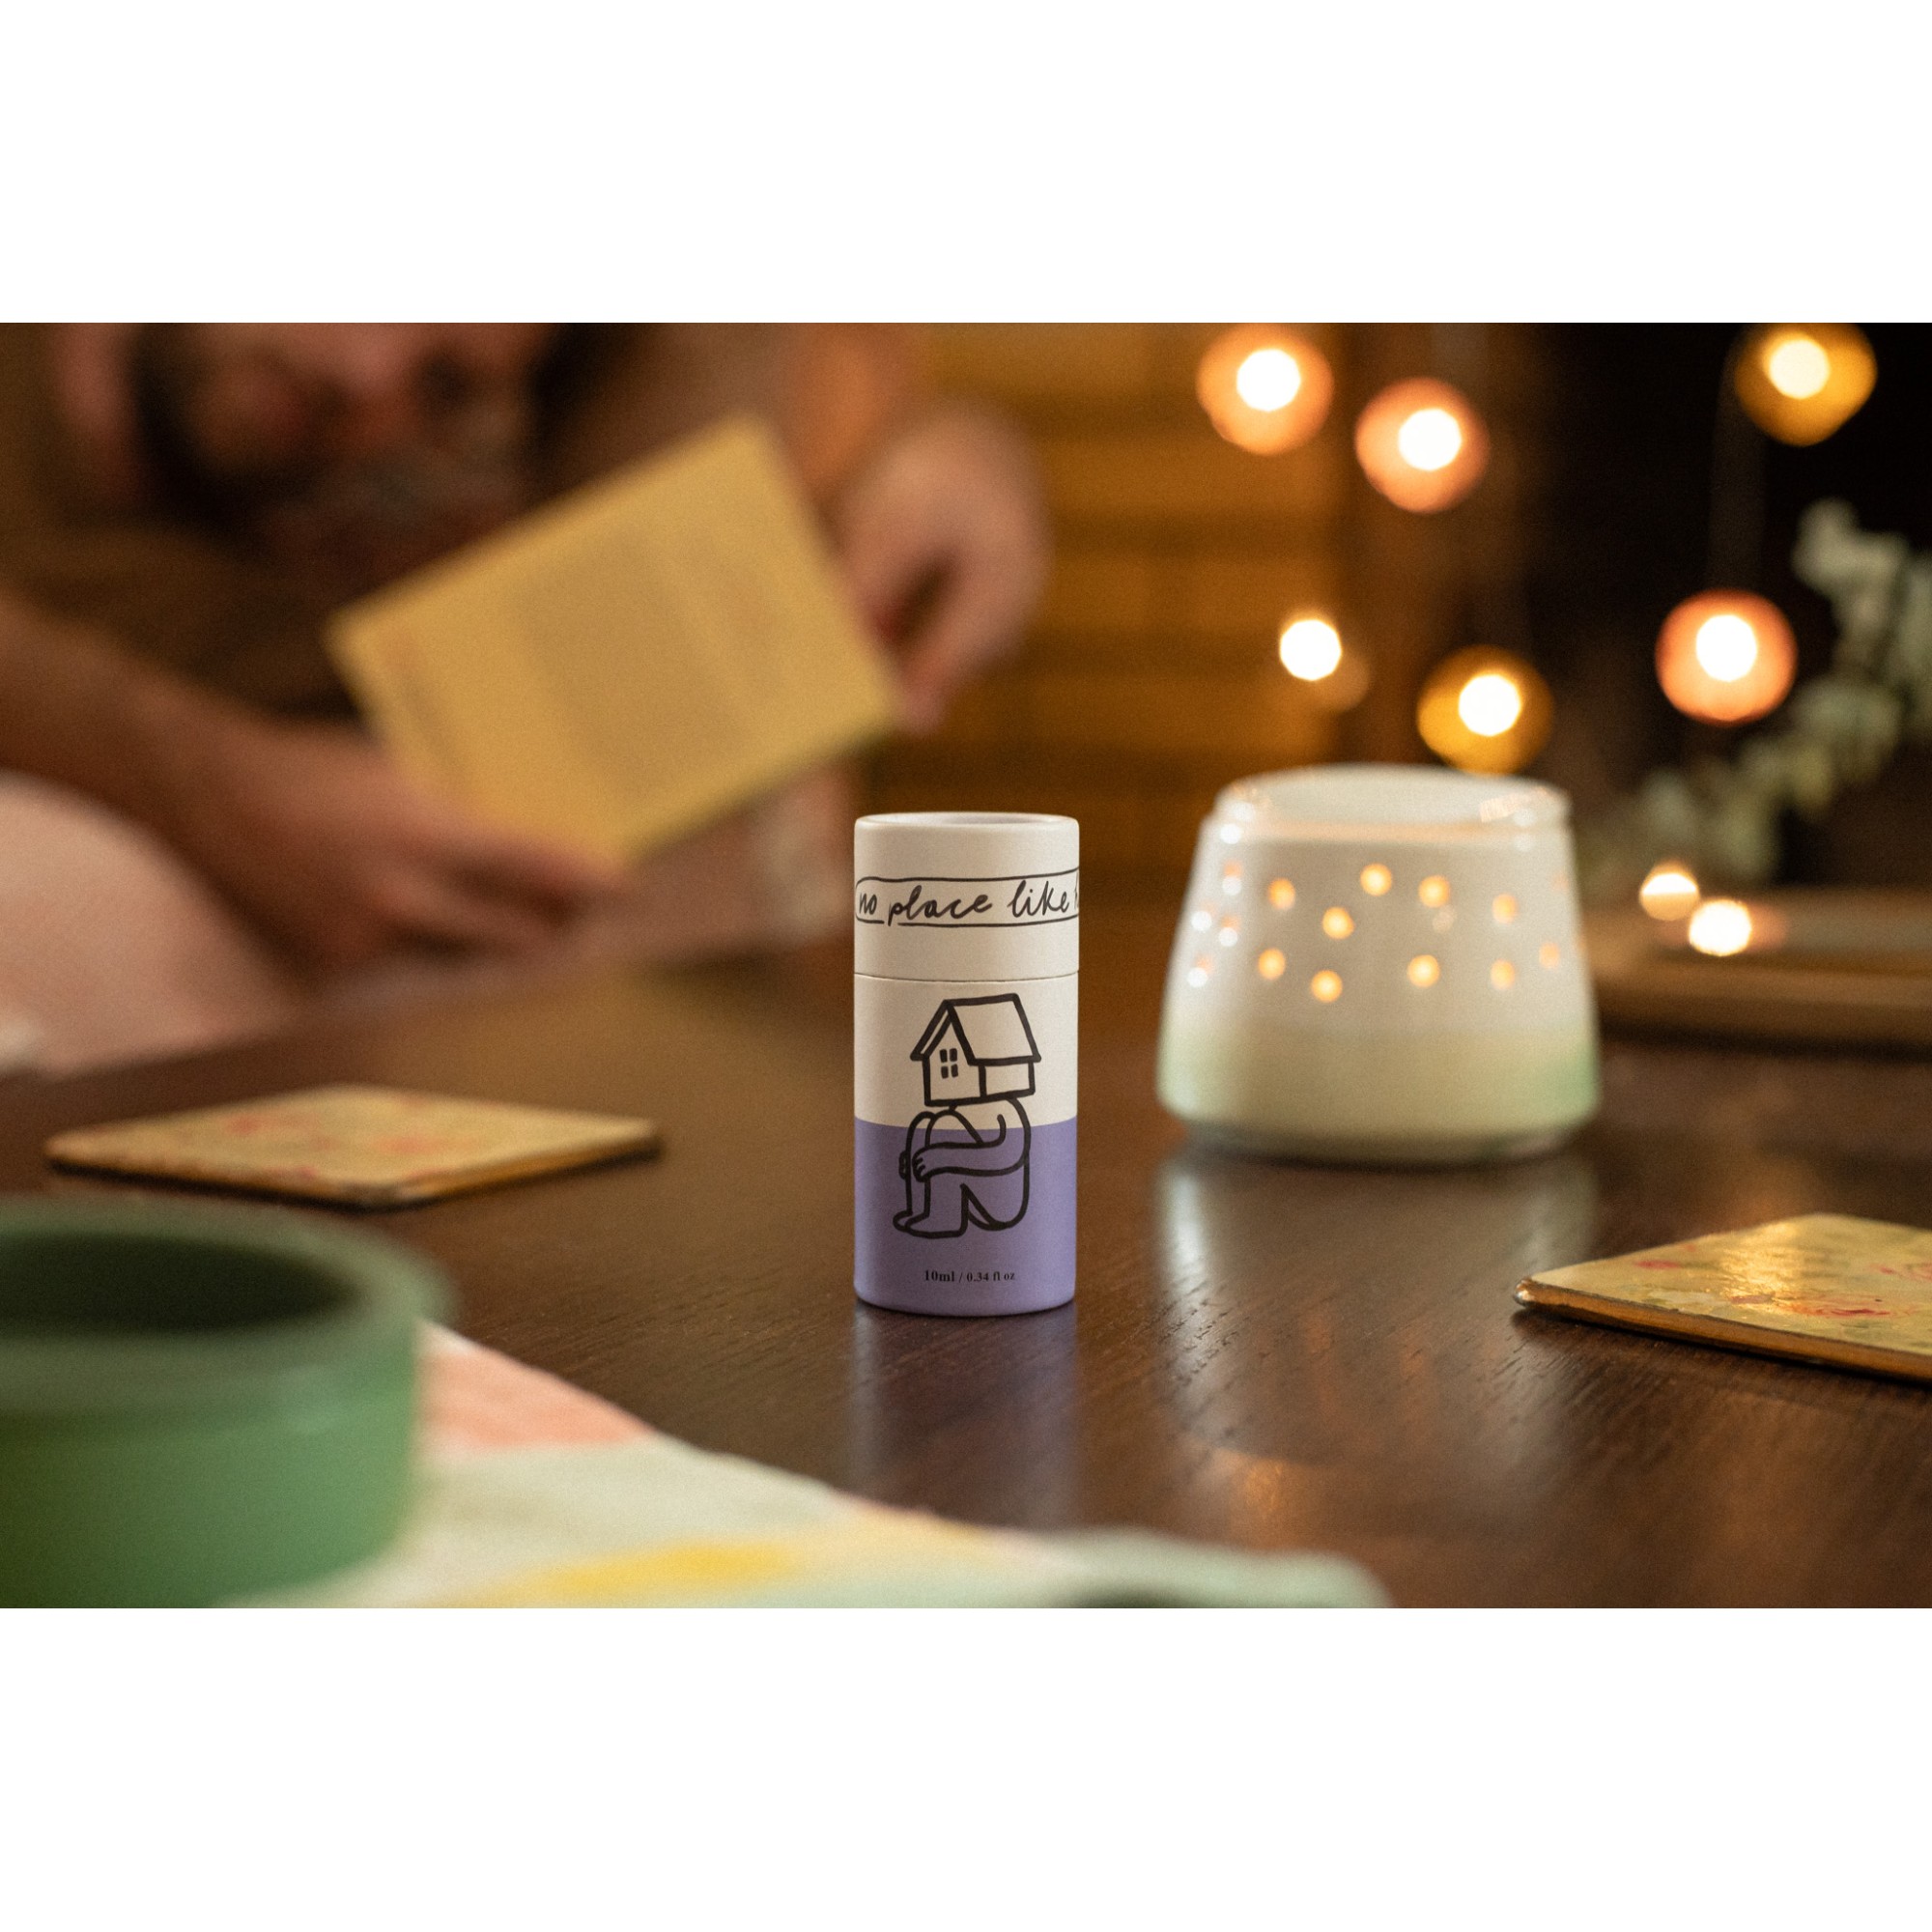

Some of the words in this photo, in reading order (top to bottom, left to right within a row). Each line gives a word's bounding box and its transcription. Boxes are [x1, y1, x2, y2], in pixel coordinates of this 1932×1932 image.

[859, 893, 878, 915] no
[888, 885, 993, 926] place
[1007, 880, 1069, 918] like
[924, 1269, 955, 1282] 10ml
[966, 1271, 989, 1282] 0.34
[993, 1271, 1001, 1282] fl
[1004, 1272, 1015, 1281] oz
